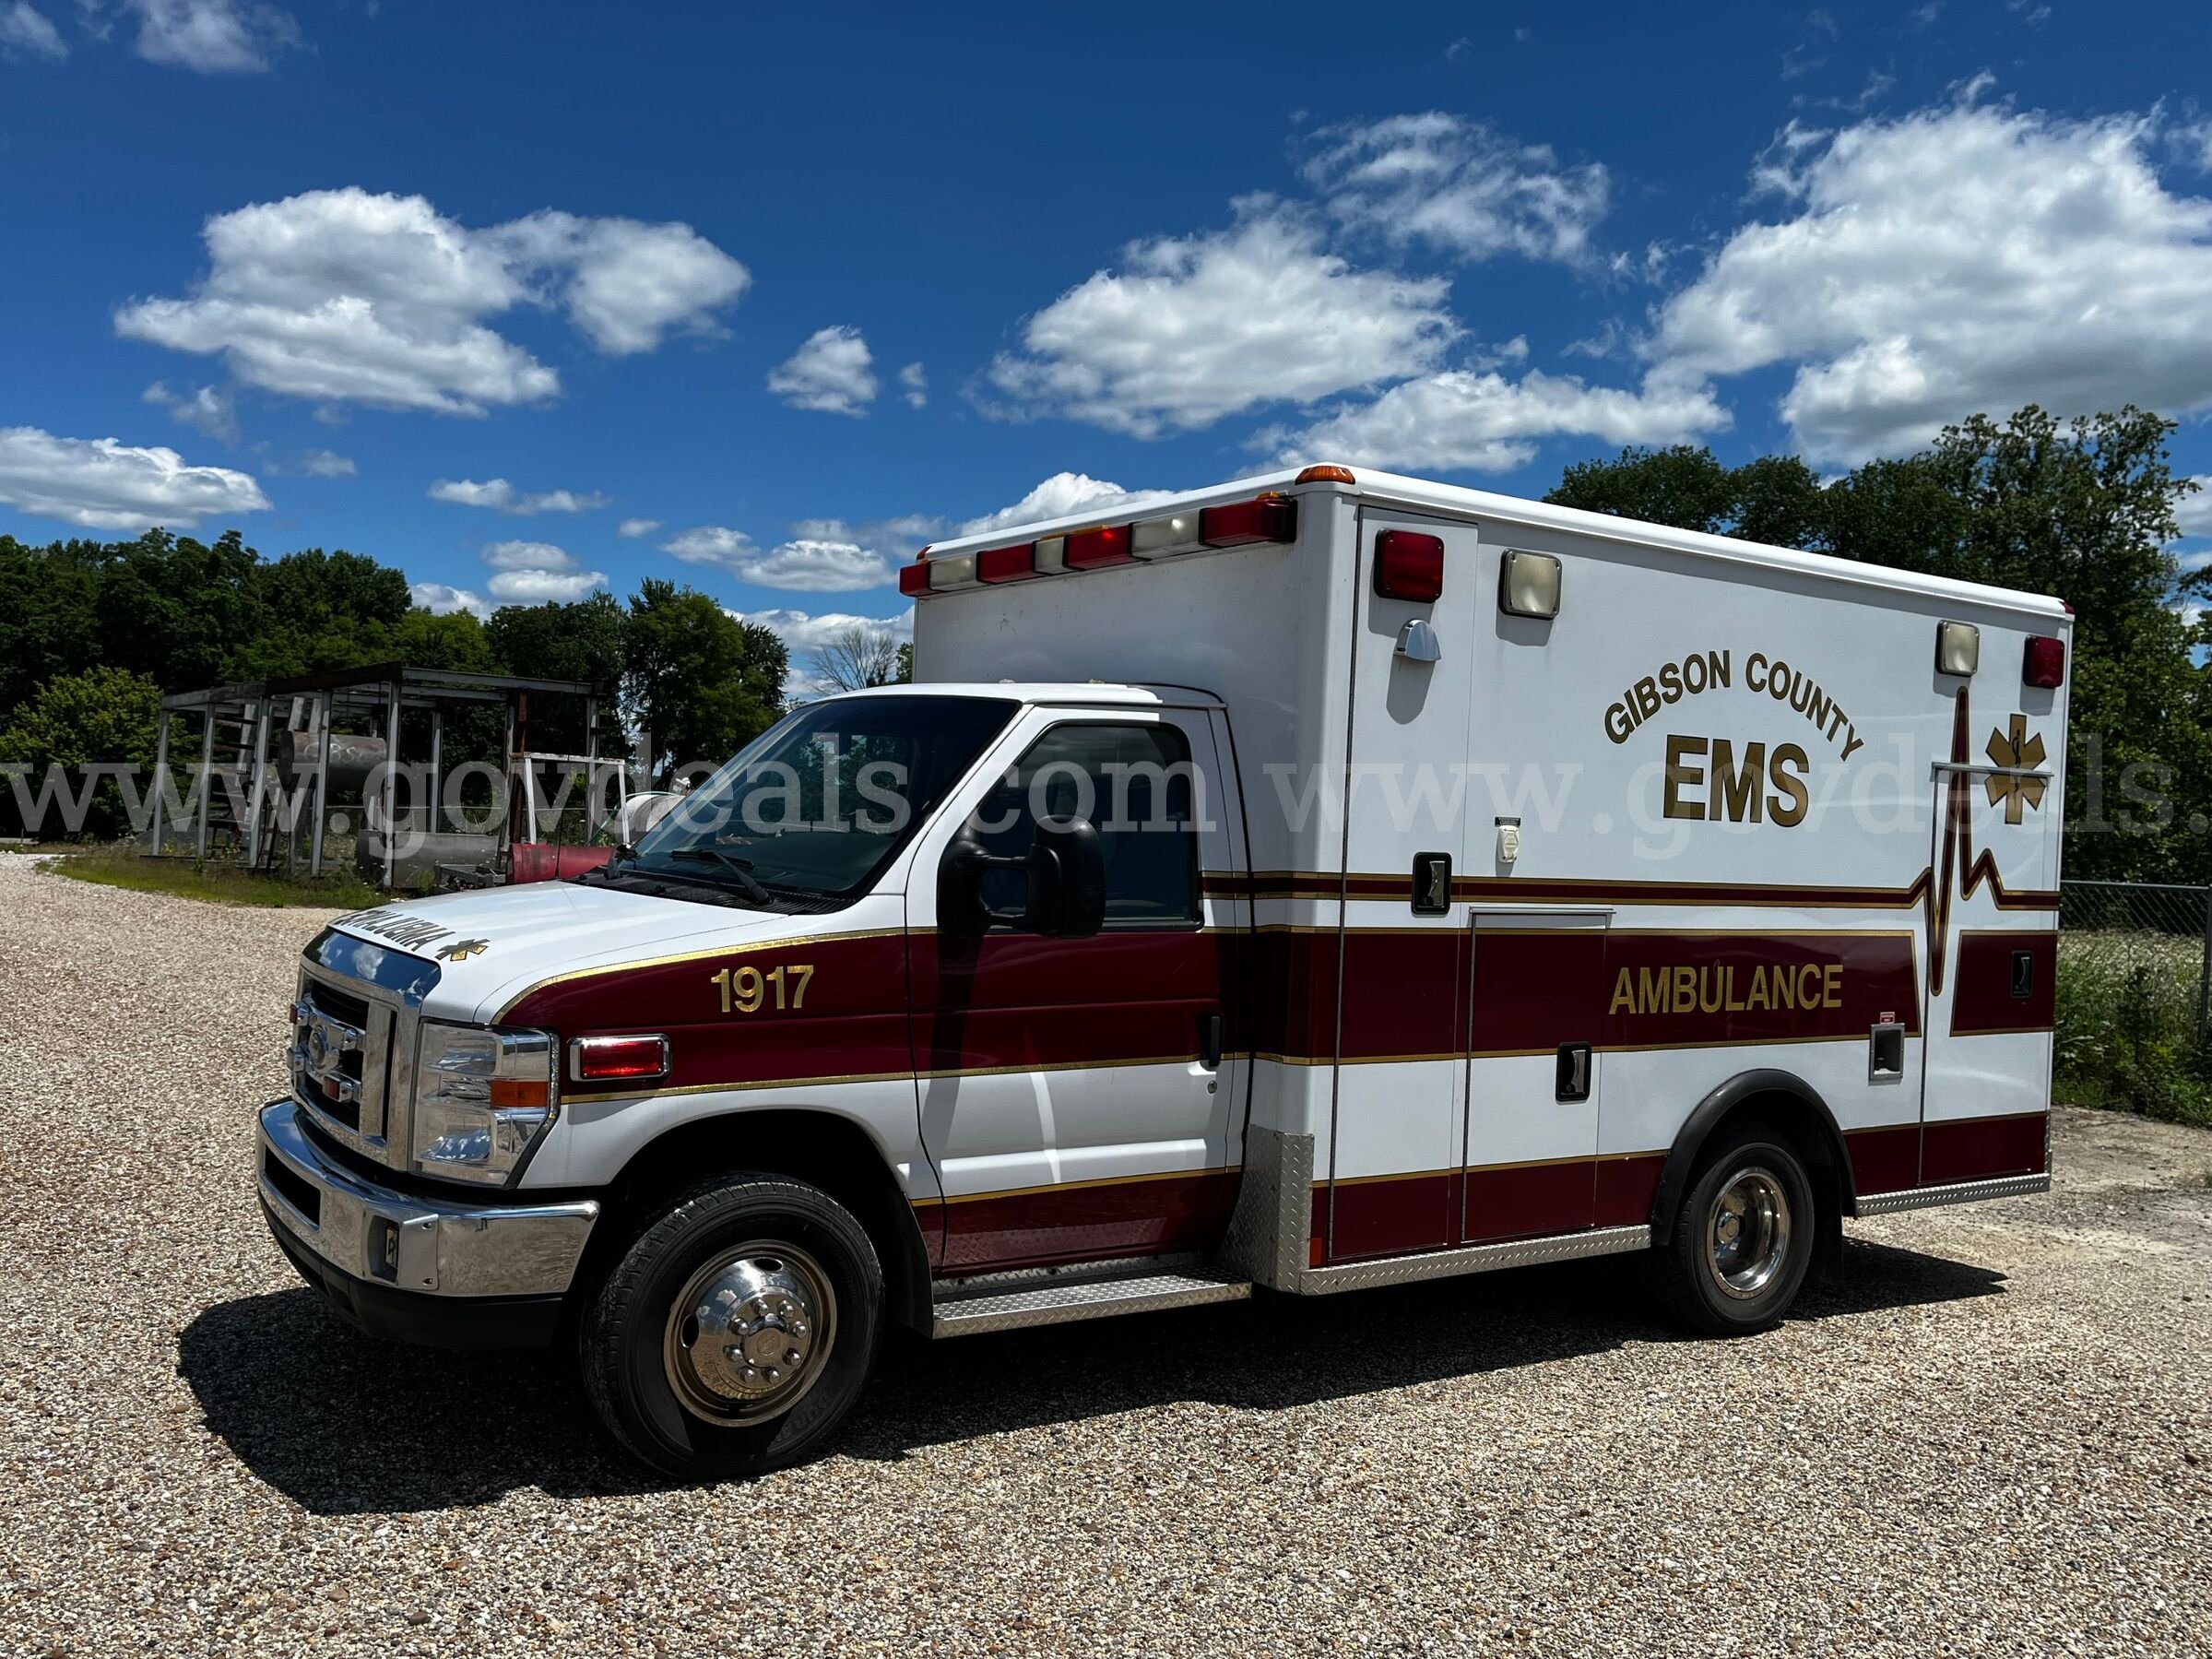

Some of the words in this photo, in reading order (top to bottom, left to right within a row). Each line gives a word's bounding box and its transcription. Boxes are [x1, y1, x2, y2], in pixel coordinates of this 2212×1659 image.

[1604, 649, 1731, 744] GIBSON
[1745, 652, 1864, 762] COUNTY
[1662, 734, 1810, 827] EMS
[711, 965, 814, 1013] 1917
[1609, 964, 1843, 1015] AMBULANCE
